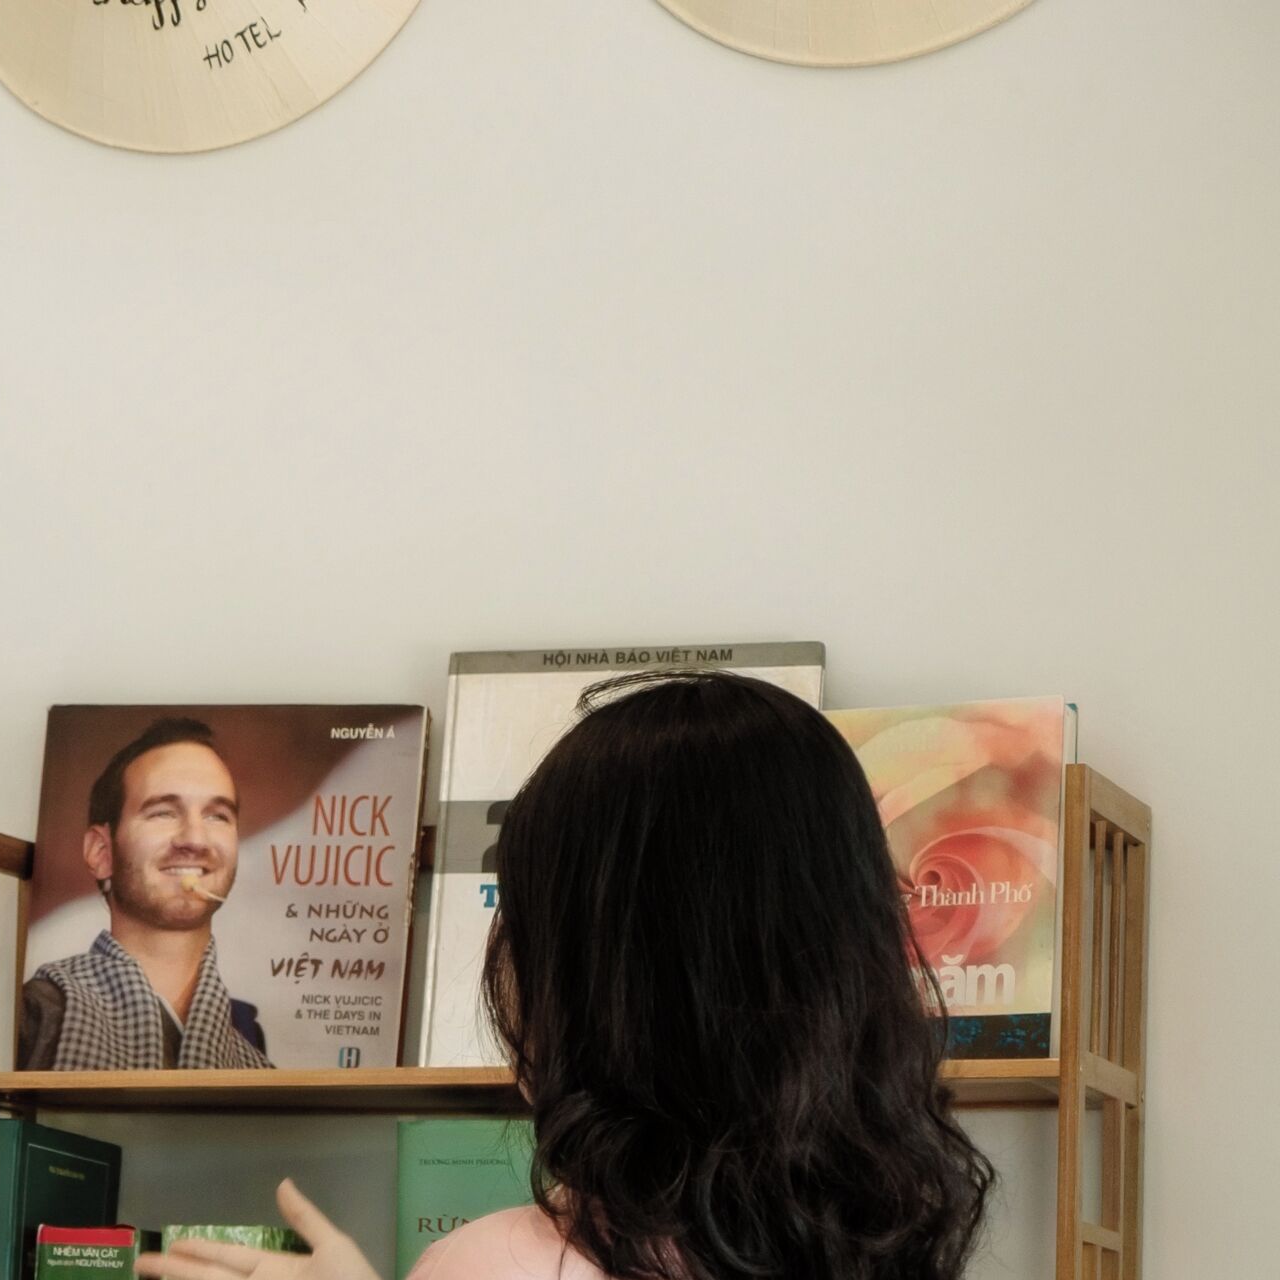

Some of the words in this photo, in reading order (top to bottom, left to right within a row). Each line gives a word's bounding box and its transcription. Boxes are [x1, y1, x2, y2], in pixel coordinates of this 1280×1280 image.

[202, 16, 282, 69] HOTEL
[543, 650, 571, 668] HỘI
[576, 649, 609, 665] NHÀ
[615, 648, 650, 665] BÁO
[656, 647, 691, 663] VIỆT
[696, 648, 733, 662] NAM
[330, 723, 385, 740] NGUYỄN
[312, 794, 392, 837] NICK
[270, 844, 396, 887] VUJICIC
[915, 882, 985, 909] Thành
[991, 880, 1033, 903] Phố
[285, 903, 299, 919] &
[307, 900, 389, 920] NHỮNG
[309, 924, 367, 944] NGÀY
[373, 921, 389, 944] Ở
[270, 952, 323, 985] VIỆT
[330, 958, 385, 981] NAM
[302, 994, 331, 1005] NICK
[334, 994, 383, 1006] VUJICIC
[294, 1009, 304, 1020] &
[306, 1009, 330, 1020] THE
[334, 1009, 365, 1021] DAYS
[369, 1010, 382, 1021] IN
[325, 1025, 380, 1036] VIETNAM
